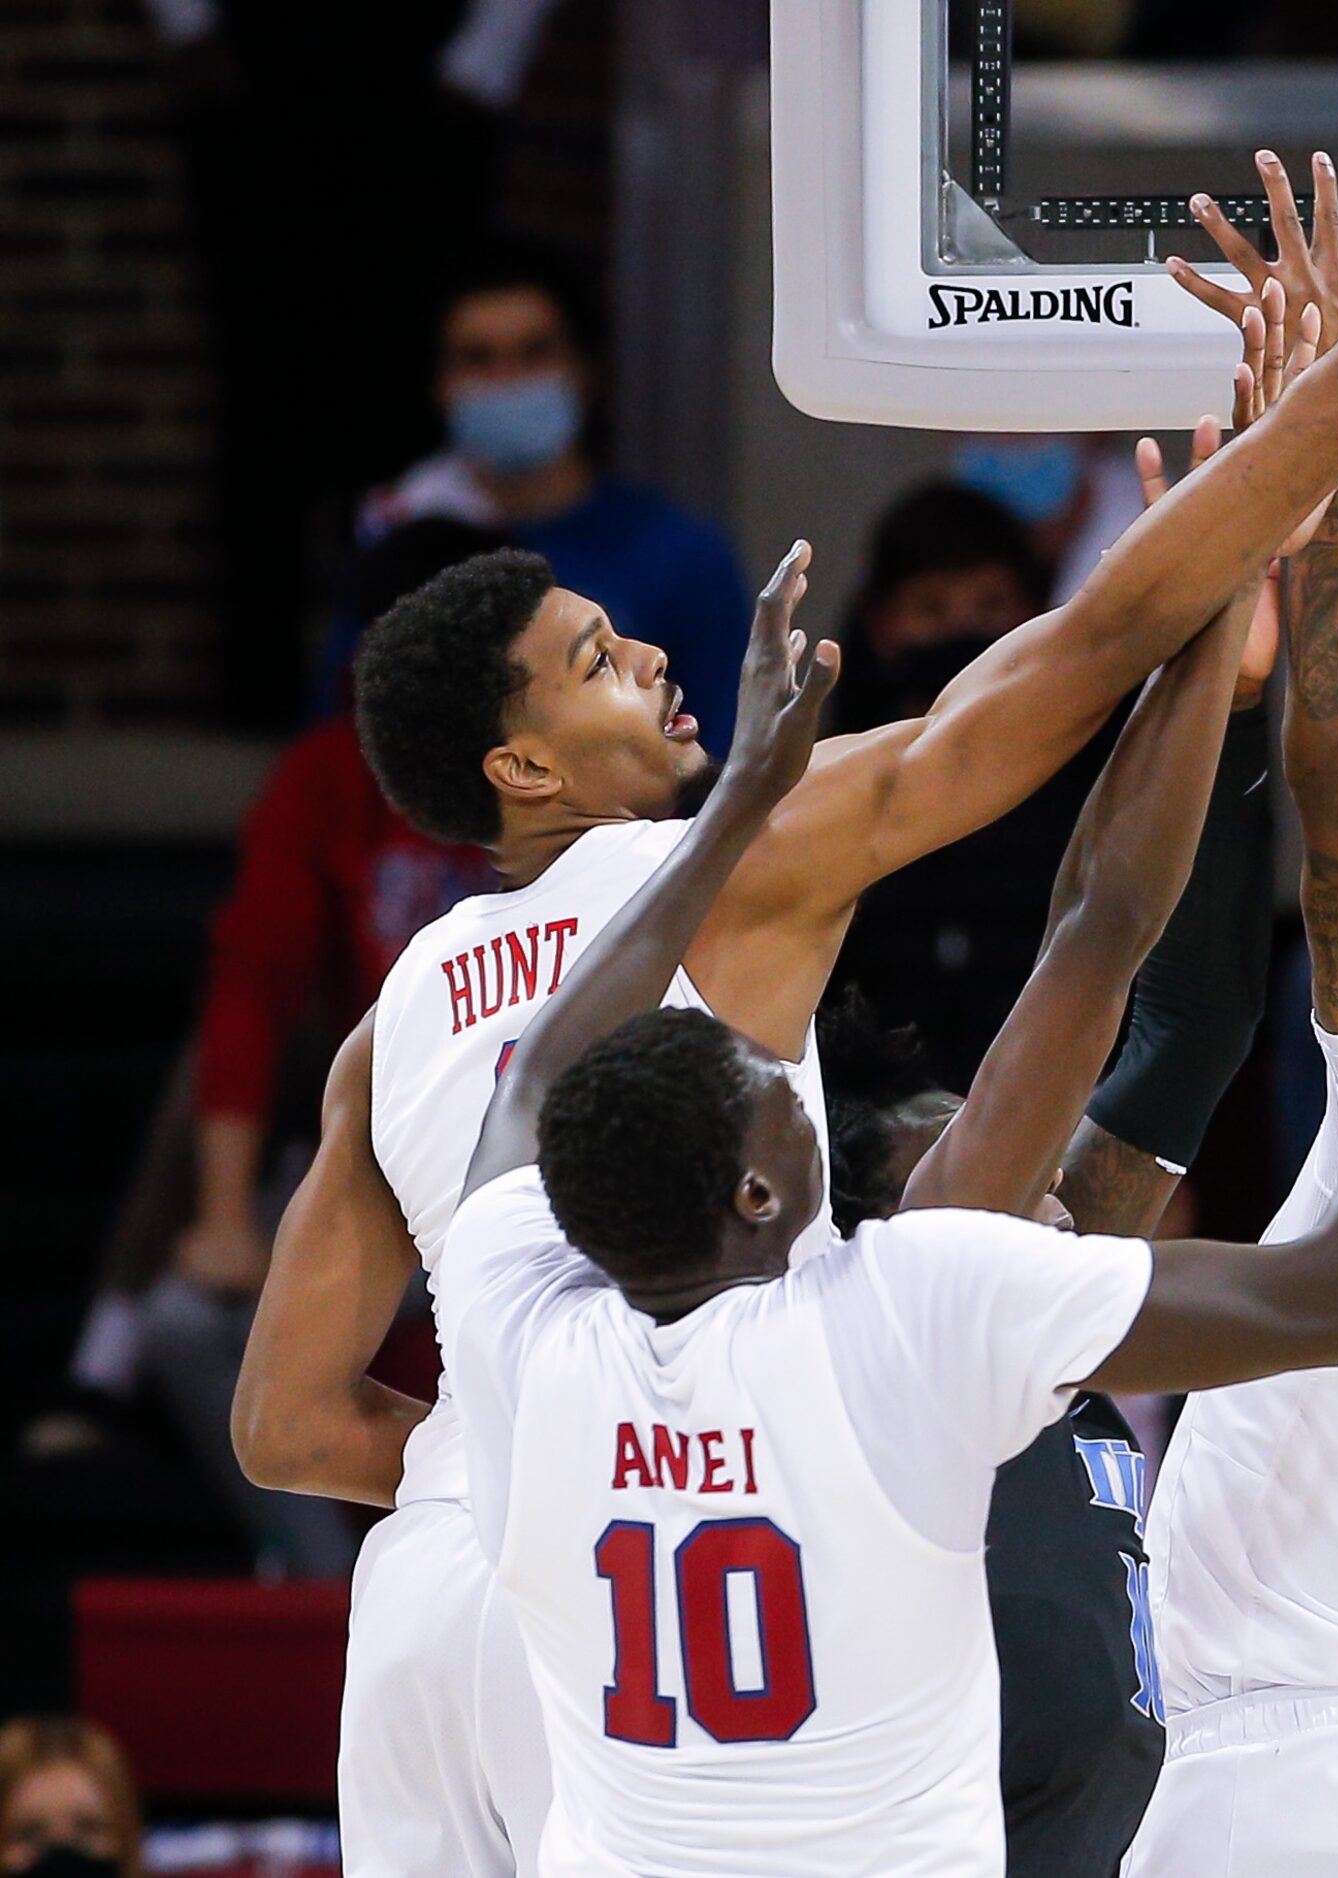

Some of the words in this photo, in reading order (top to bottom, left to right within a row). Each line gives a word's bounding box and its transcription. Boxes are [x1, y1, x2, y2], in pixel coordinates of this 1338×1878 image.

[928, 281, 1134, 329] SPALDING
[441, 917, 579, 1035] HUNT
[612, 1421, 758, 1494] ANEI
[594, 1517, 817, 1748] 10
